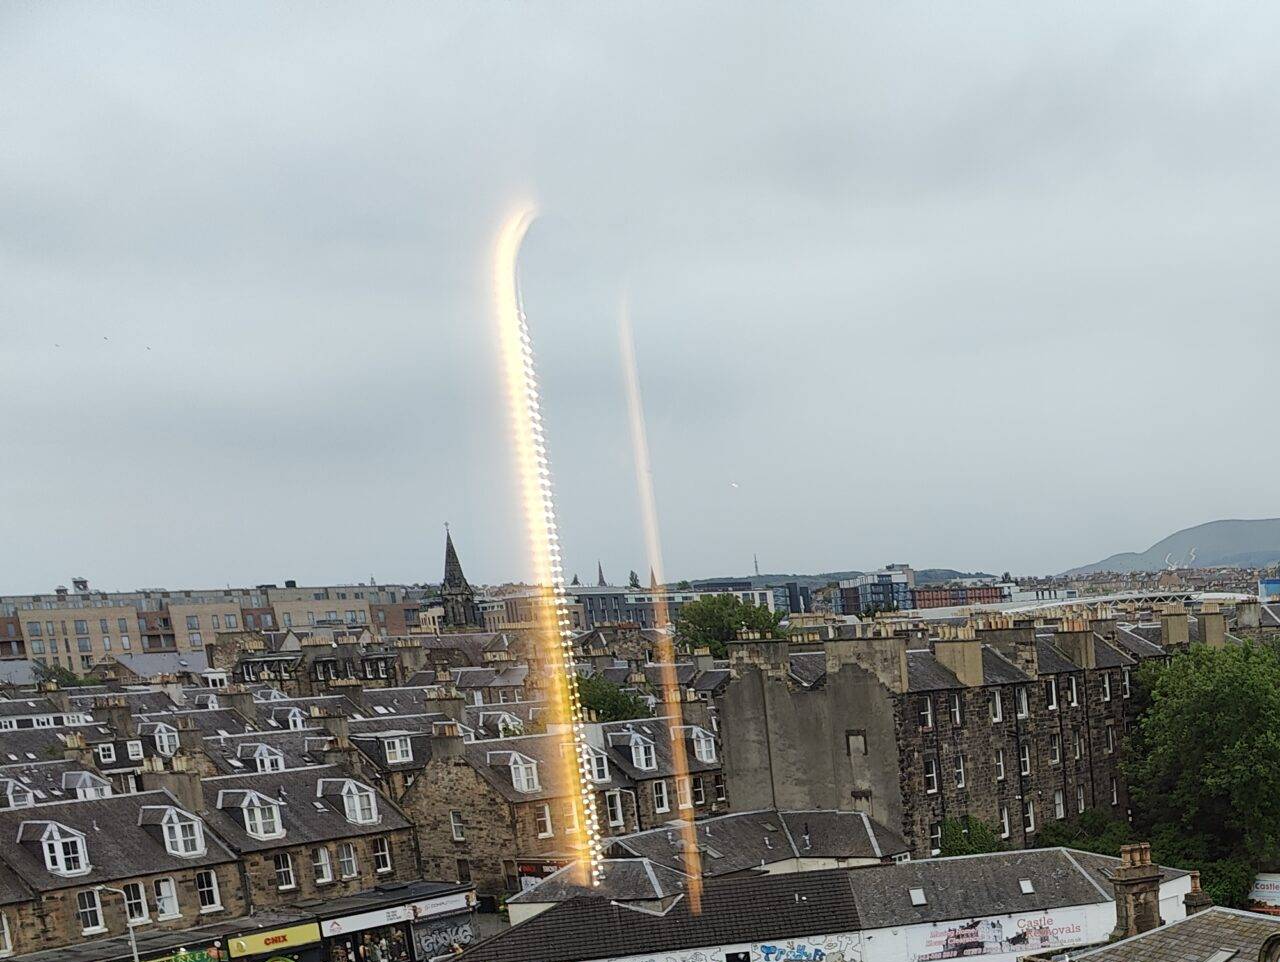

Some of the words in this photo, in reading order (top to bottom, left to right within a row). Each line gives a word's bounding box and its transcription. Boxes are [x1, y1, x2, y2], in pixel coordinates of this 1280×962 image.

[1254, 882, 1280, 892] Castle
[1017, 916, 1053, 928] Castle
[1025, 923, 1081, 938] Removals
